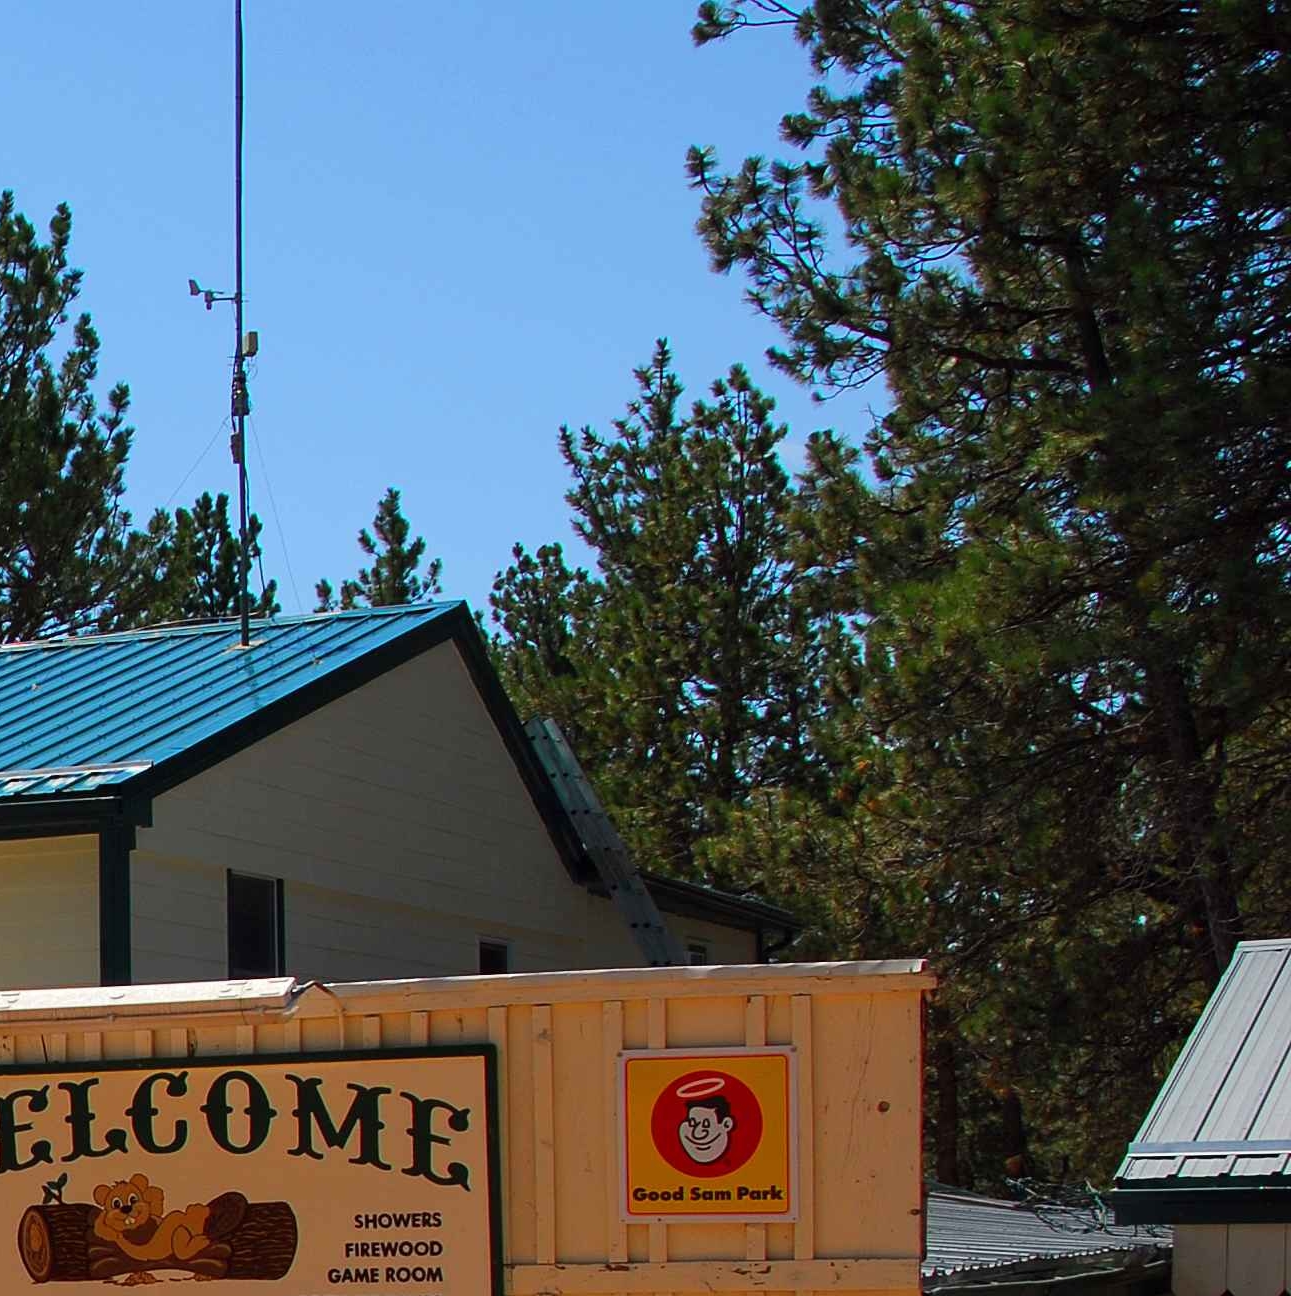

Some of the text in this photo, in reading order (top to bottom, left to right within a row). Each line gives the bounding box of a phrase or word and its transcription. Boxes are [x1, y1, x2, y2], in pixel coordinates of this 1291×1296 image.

[632, 1185, 784, 1201] Good Sam Park
[353, 1211, 443, 1230] SHOWERS
[344, 1241, 444, 1259] FIREWOOD
[326, 1266, 444, 1284] GAME ROOM
